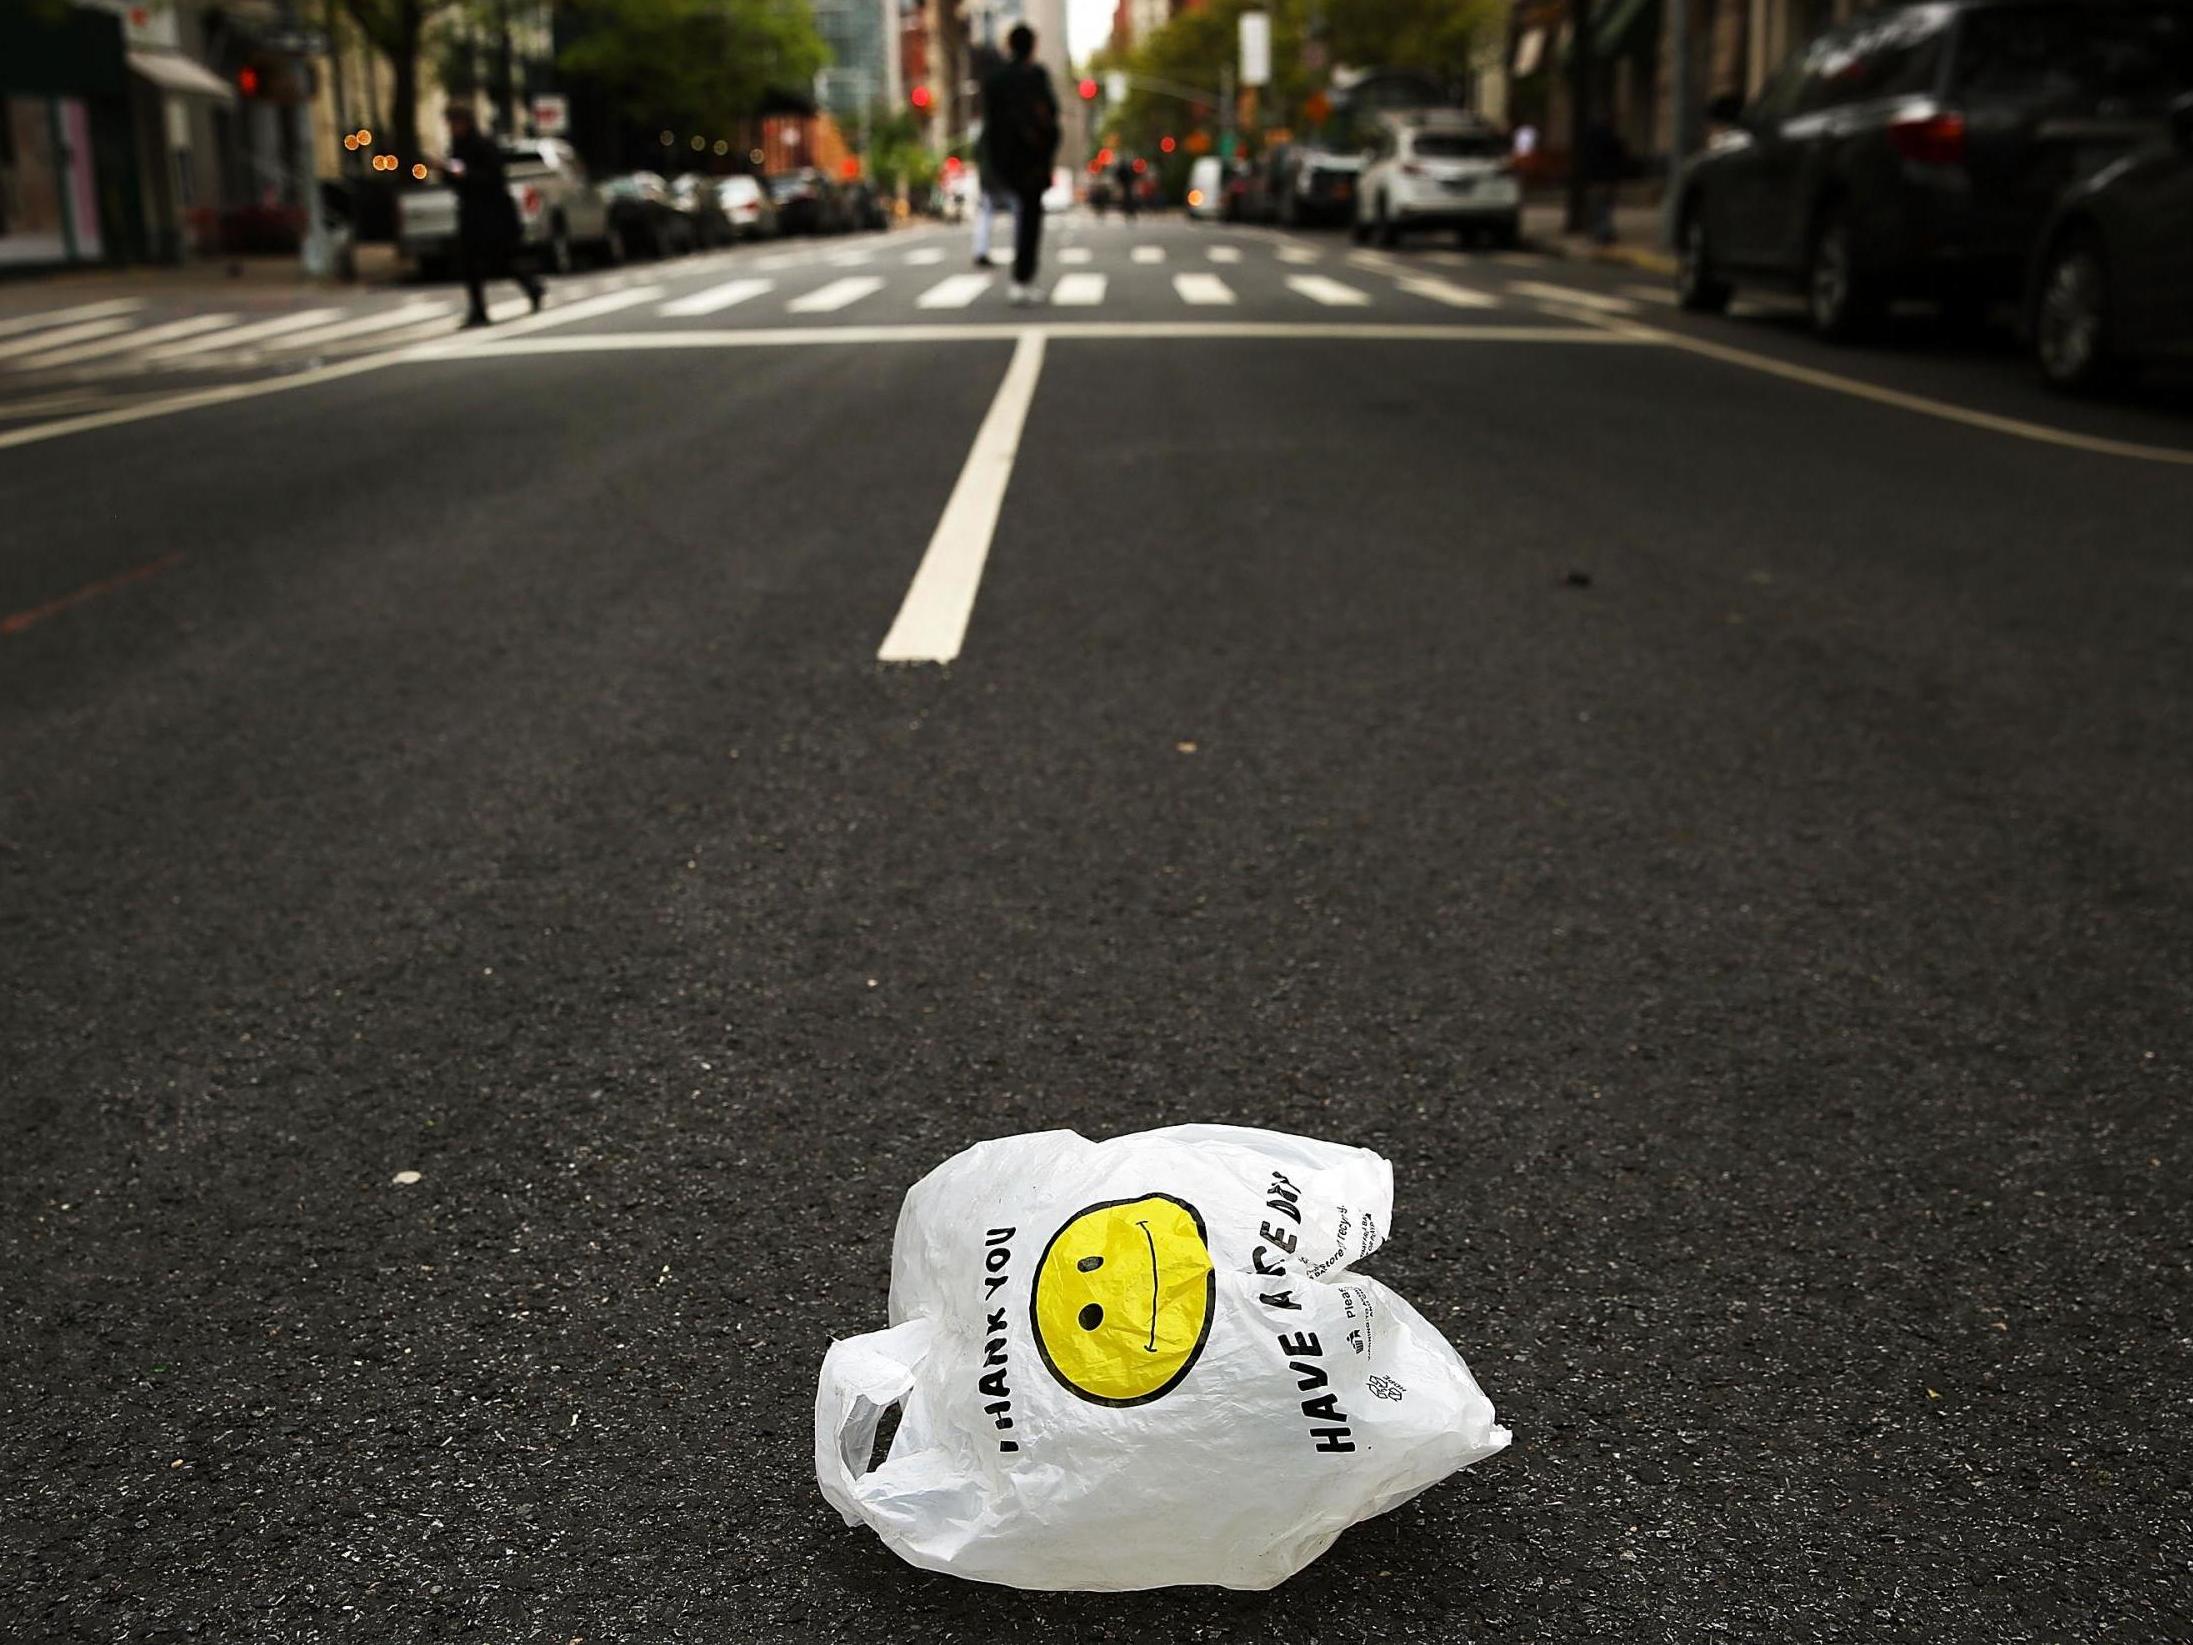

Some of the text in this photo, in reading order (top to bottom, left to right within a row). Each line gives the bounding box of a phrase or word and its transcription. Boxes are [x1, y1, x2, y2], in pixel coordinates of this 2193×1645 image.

[985, 1227, 1016, 1301] YOU
[1259, 1290, 1302, 1310] A
[1278, 1331, 1355, 1452] HAVE
